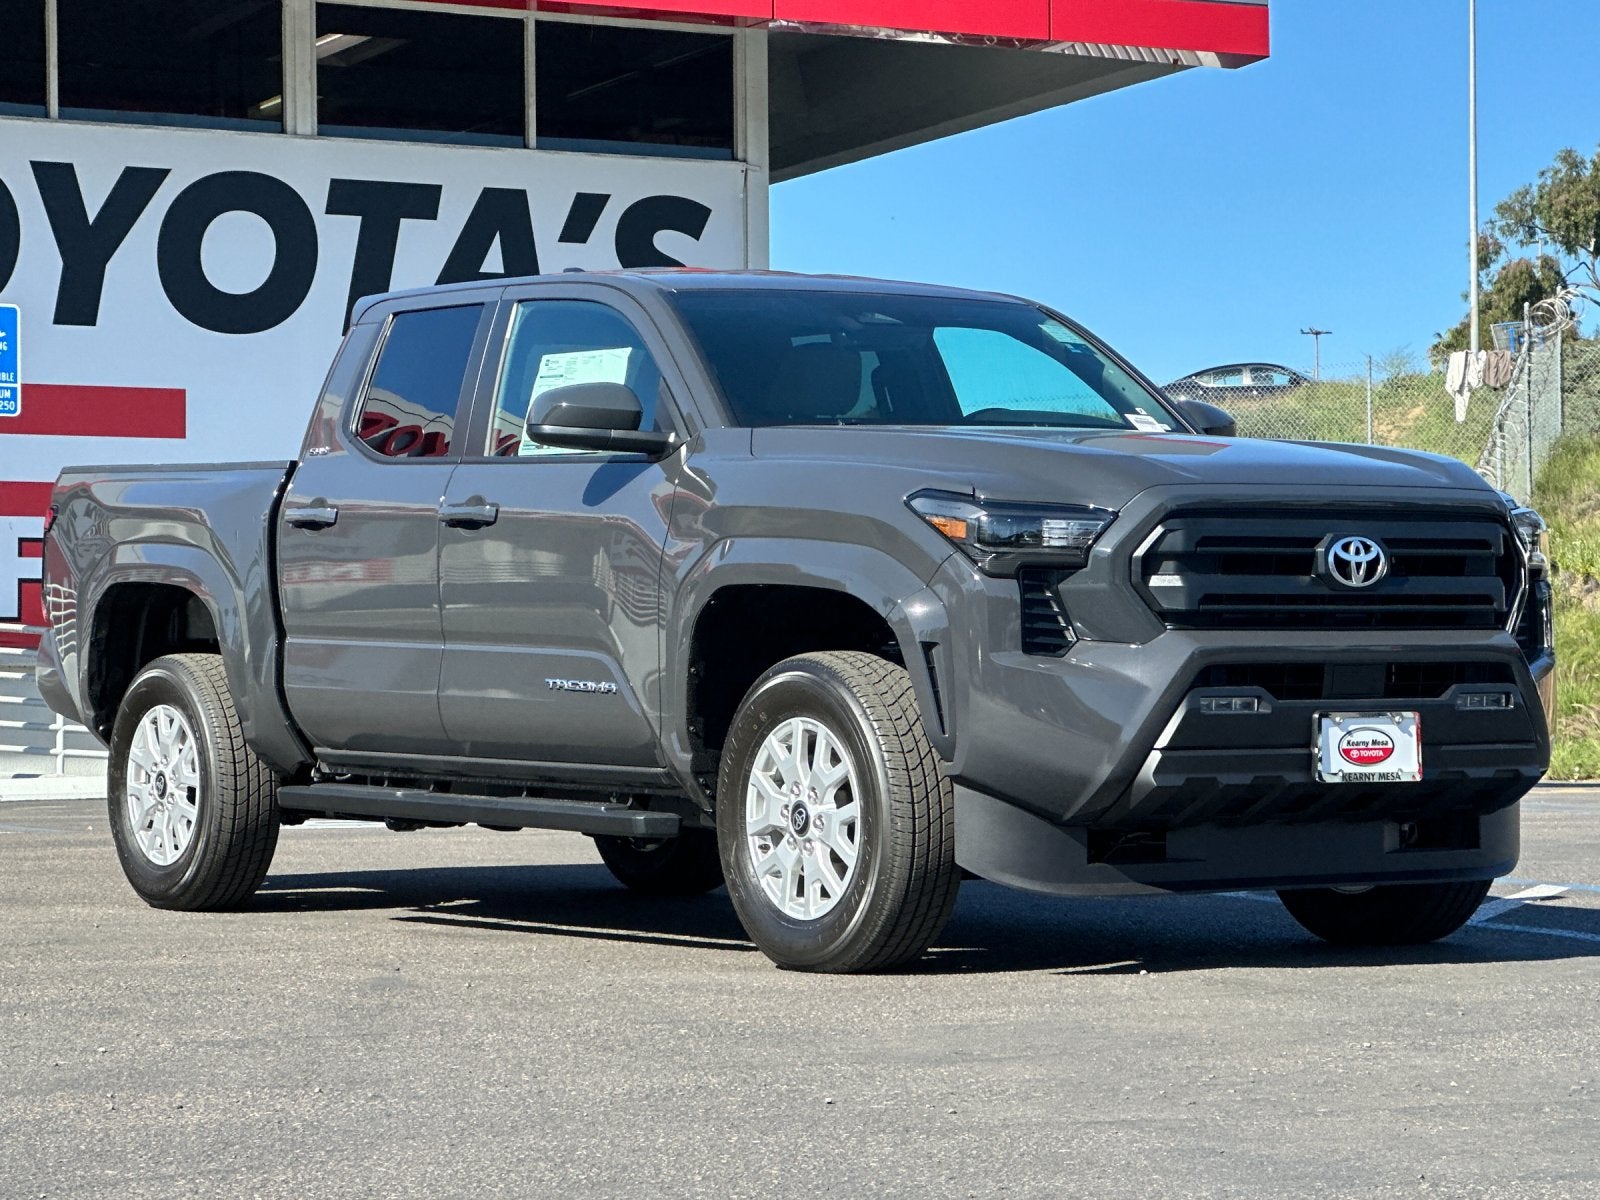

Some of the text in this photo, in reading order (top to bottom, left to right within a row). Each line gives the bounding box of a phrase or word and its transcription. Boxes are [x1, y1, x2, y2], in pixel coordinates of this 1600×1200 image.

[0, 160, 711, 336] YOTA'
[544, 678, 617, 694] TACOMA
[1346, 739, 1370, 747] Kearny
[1342, 772, 1401, 782] KEARNY MESA
